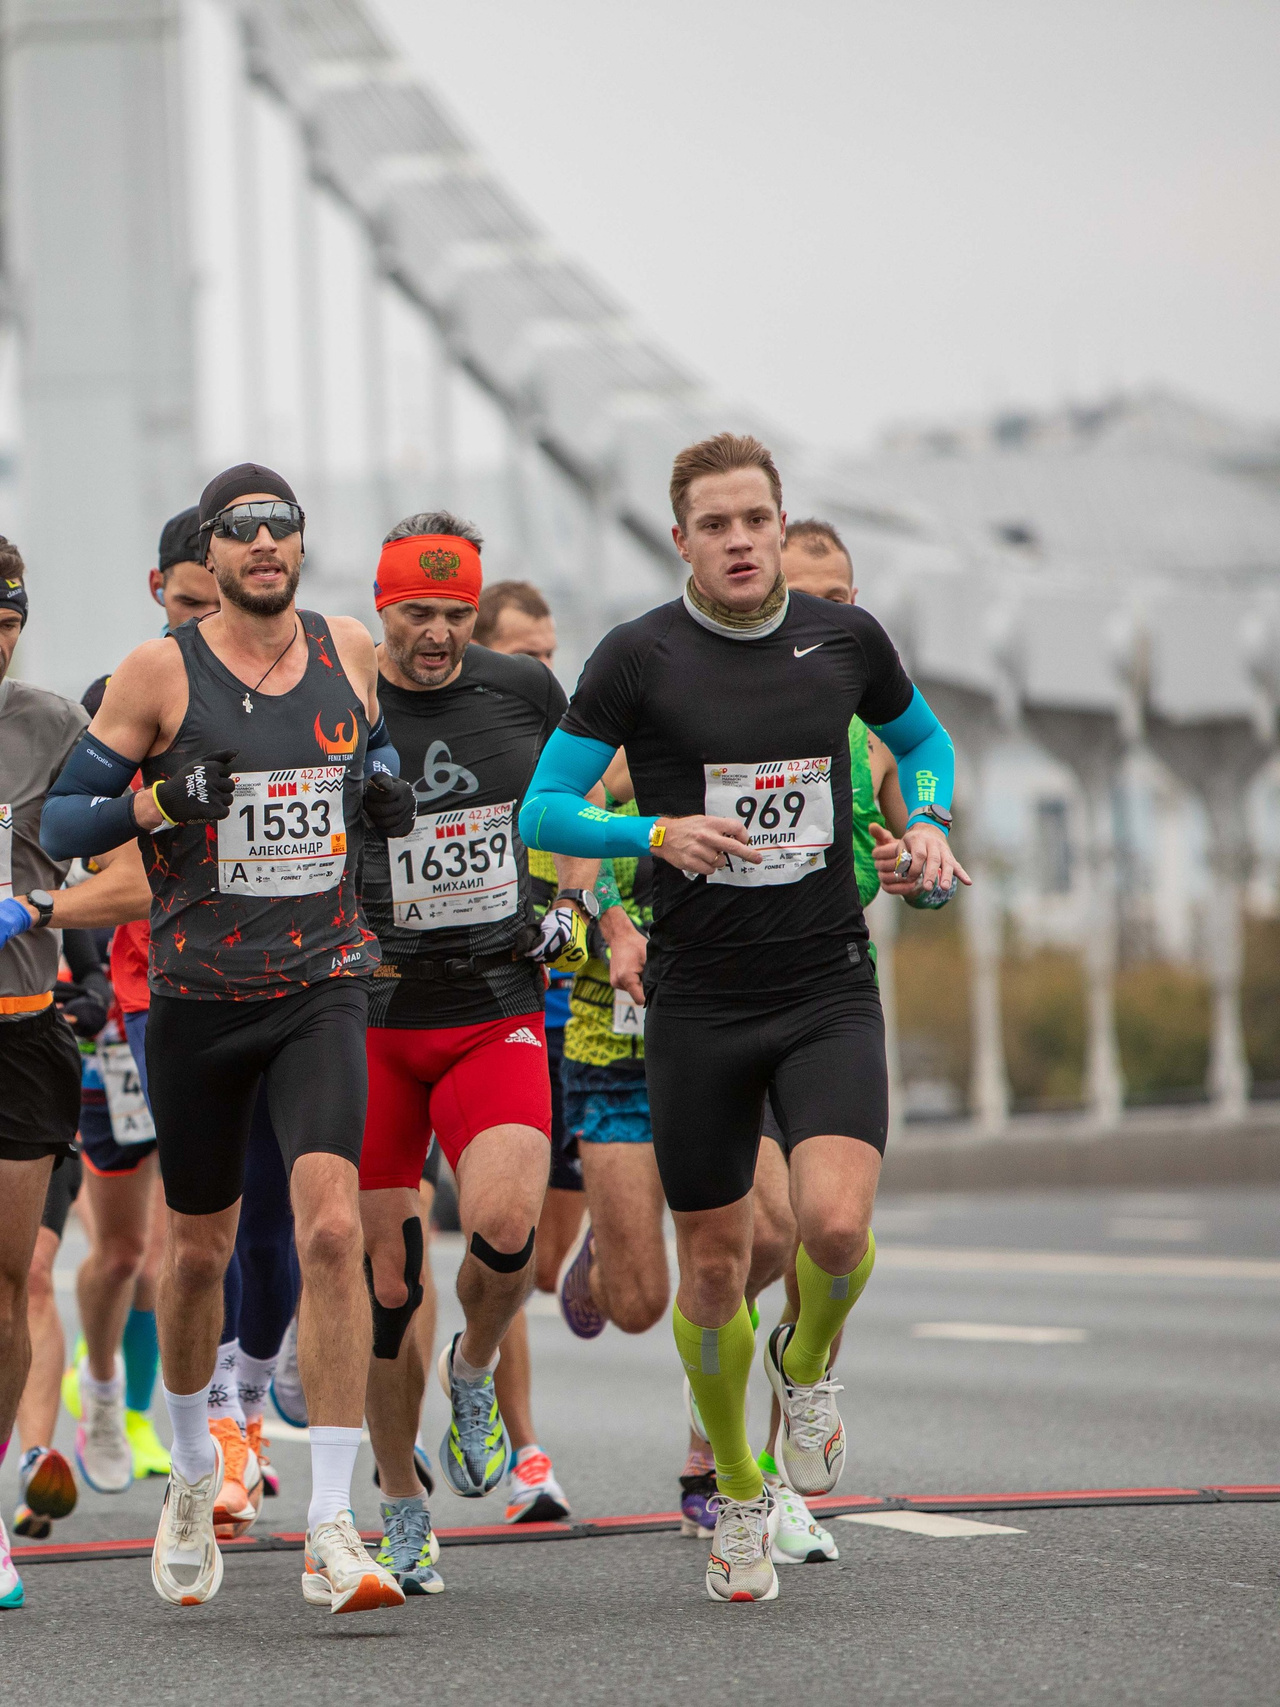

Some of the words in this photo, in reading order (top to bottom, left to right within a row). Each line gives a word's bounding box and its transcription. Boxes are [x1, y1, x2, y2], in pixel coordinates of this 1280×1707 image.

[327, 754, 342, 762] FENIX
[342, 753, 354, 761] TEAM
[786, 759, 810, 772] 42,2
[300, 768, 323, 780] 42,2
[185, 773, 196, 798] PARK
[468, 808, 492, 820] 42,2
[735, 791, 806, 830] 969
[239, 799, 331, 842] 1533
[248, 842, 323, 857] АЛЕКСАНДР
[397, 832, 508, 885] 16359
[230, 863, 249, 883] A
[432, 877, 484, 894] МИХАИЛ
[405, 903, 423, 922] A
[343, 952, 361, 964] MAD
[623, 1006, 638, 1025] A
[504, 1037, 543, 1048] adidas
